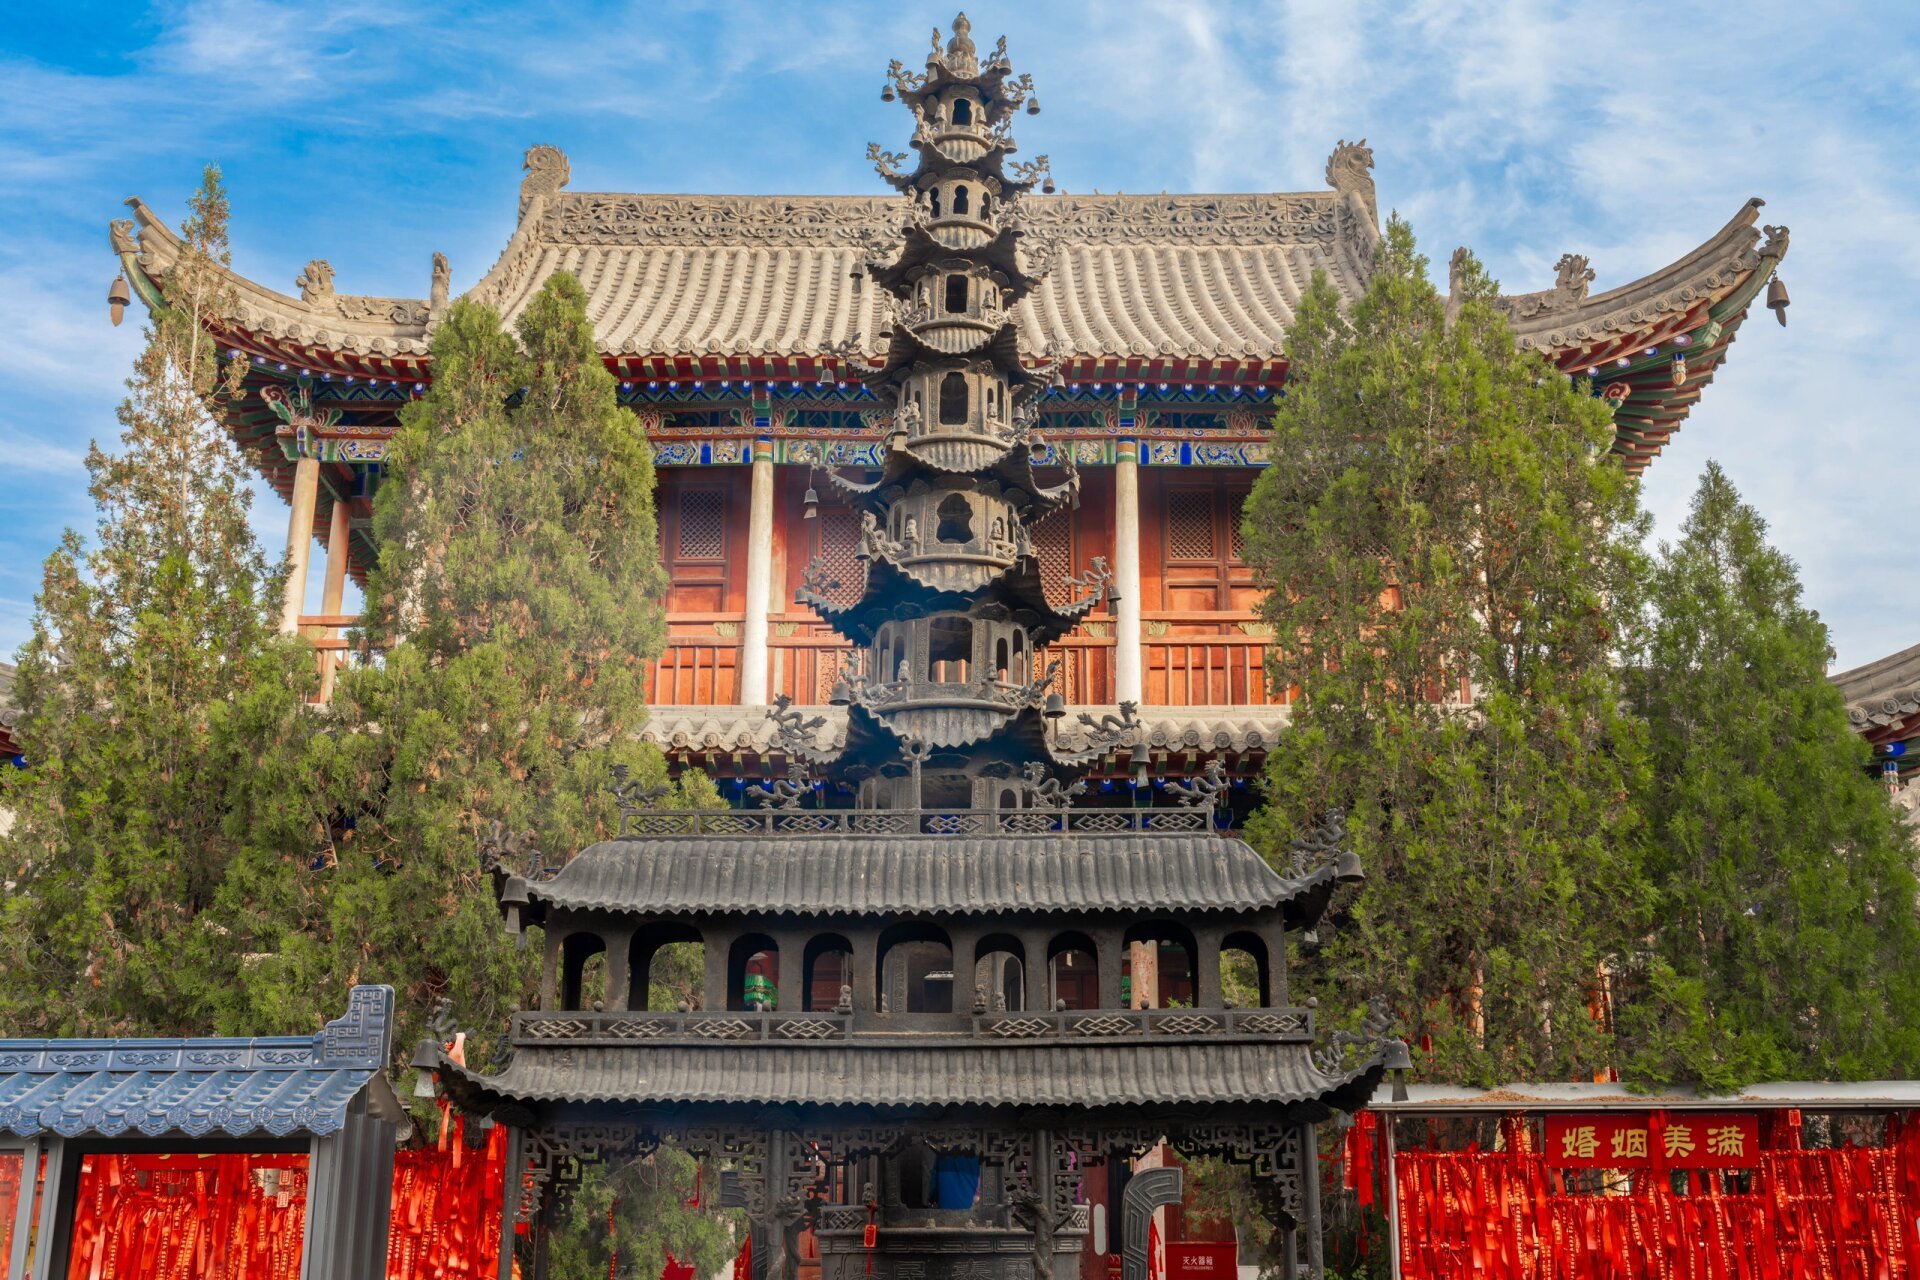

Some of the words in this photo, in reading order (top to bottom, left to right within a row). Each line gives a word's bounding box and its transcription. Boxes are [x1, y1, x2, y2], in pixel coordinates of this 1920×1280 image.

[1561, 1124, 1746, 1159] 婚姻美满
[1182, 1256, 1213, 1266] 灭火器箱
